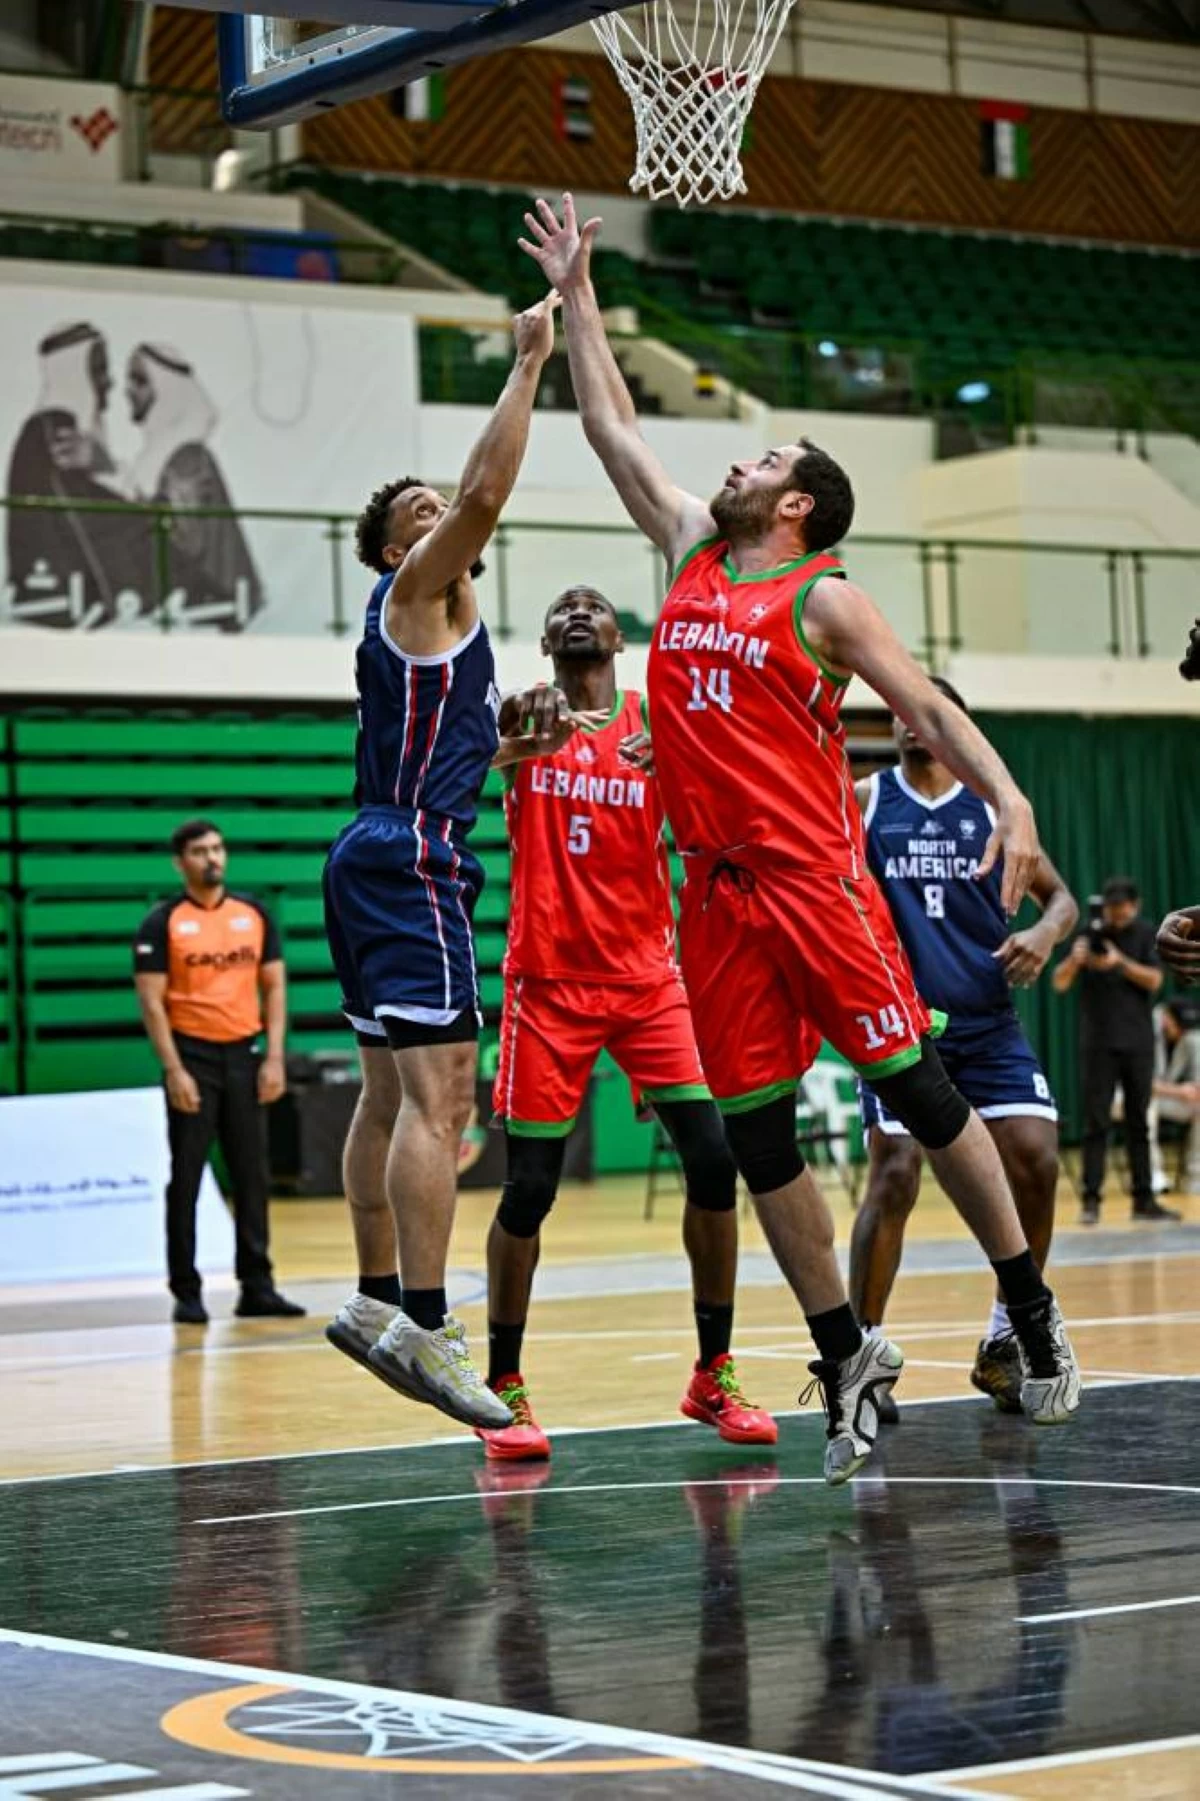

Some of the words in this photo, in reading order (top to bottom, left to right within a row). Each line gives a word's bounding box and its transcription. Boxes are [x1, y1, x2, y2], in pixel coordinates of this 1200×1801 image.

[687, 667, 734, 713] 14
[531, 765, 645, 808] LEBANON
[567, 814, 592, 855] 5
[908, 839, 956, 855] NORTH
[884, 856, 979, 879] AMERICA
[924, 885, 945, 919] 8
[856, 1003, 905, 1050] 14
